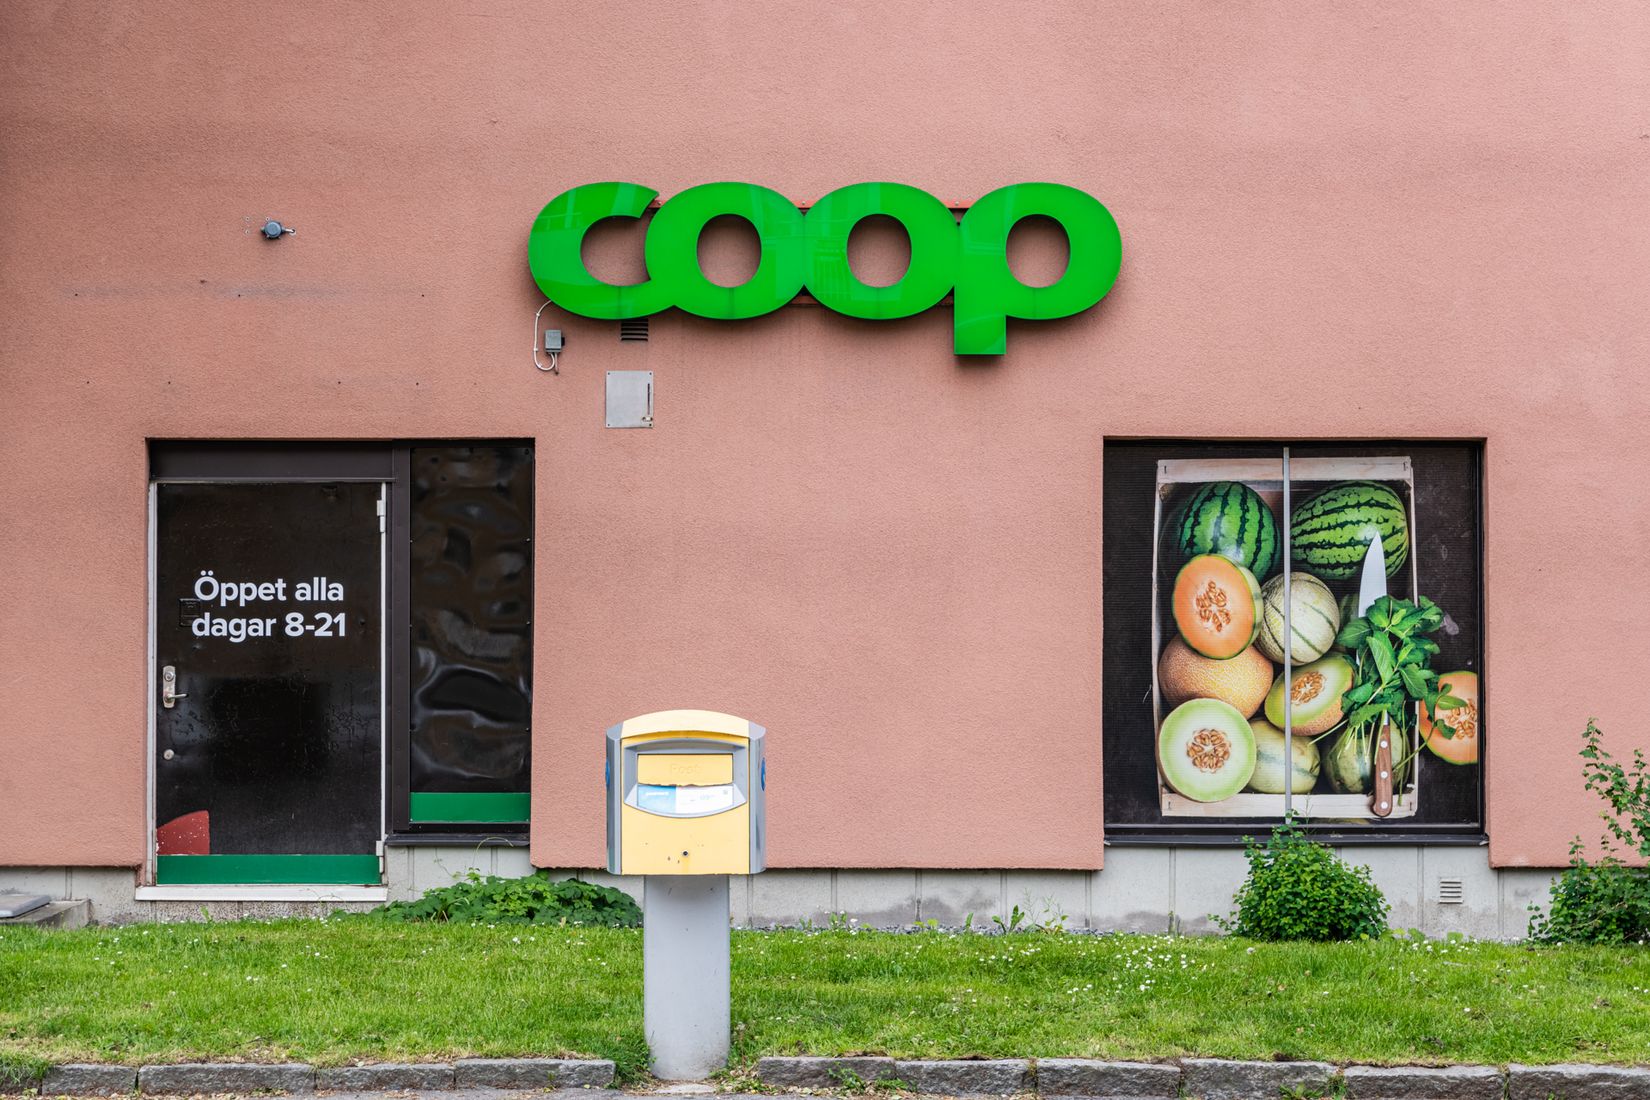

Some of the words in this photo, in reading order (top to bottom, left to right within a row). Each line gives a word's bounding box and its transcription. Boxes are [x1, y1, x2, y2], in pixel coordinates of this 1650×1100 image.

[528, 182, 1122, 356] coop
[194, 570, 287, 607] Öppet
[295, 577, 344, 602] alla
[192, 612, 277, 643] dagar
[285, 612, 346, 637] 8-21
